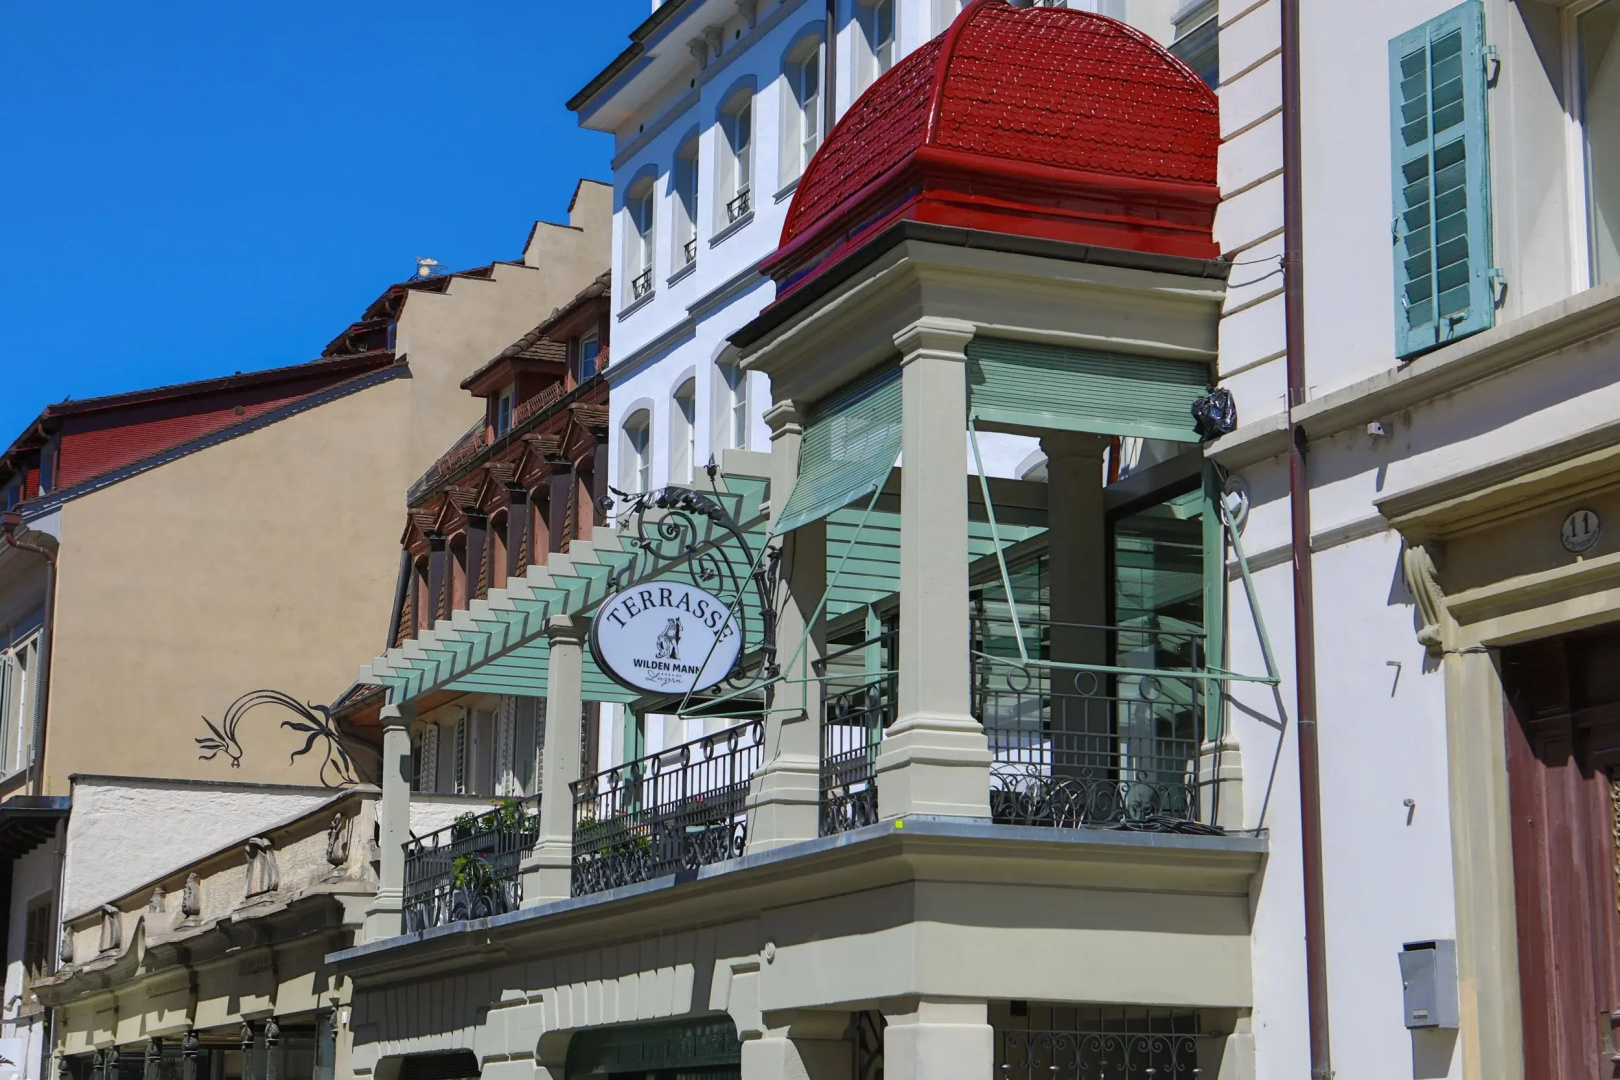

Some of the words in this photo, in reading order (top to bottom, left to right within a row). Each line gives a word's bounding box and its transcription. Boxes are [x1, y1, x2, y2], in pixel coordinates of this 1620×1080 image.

[1570, 512, 1590, 538] 11
[606, 587, 734, 643] TERRASSE
[633, 658, 671, 672] WILDEN
[645, 669, 684, 687] Luzern
